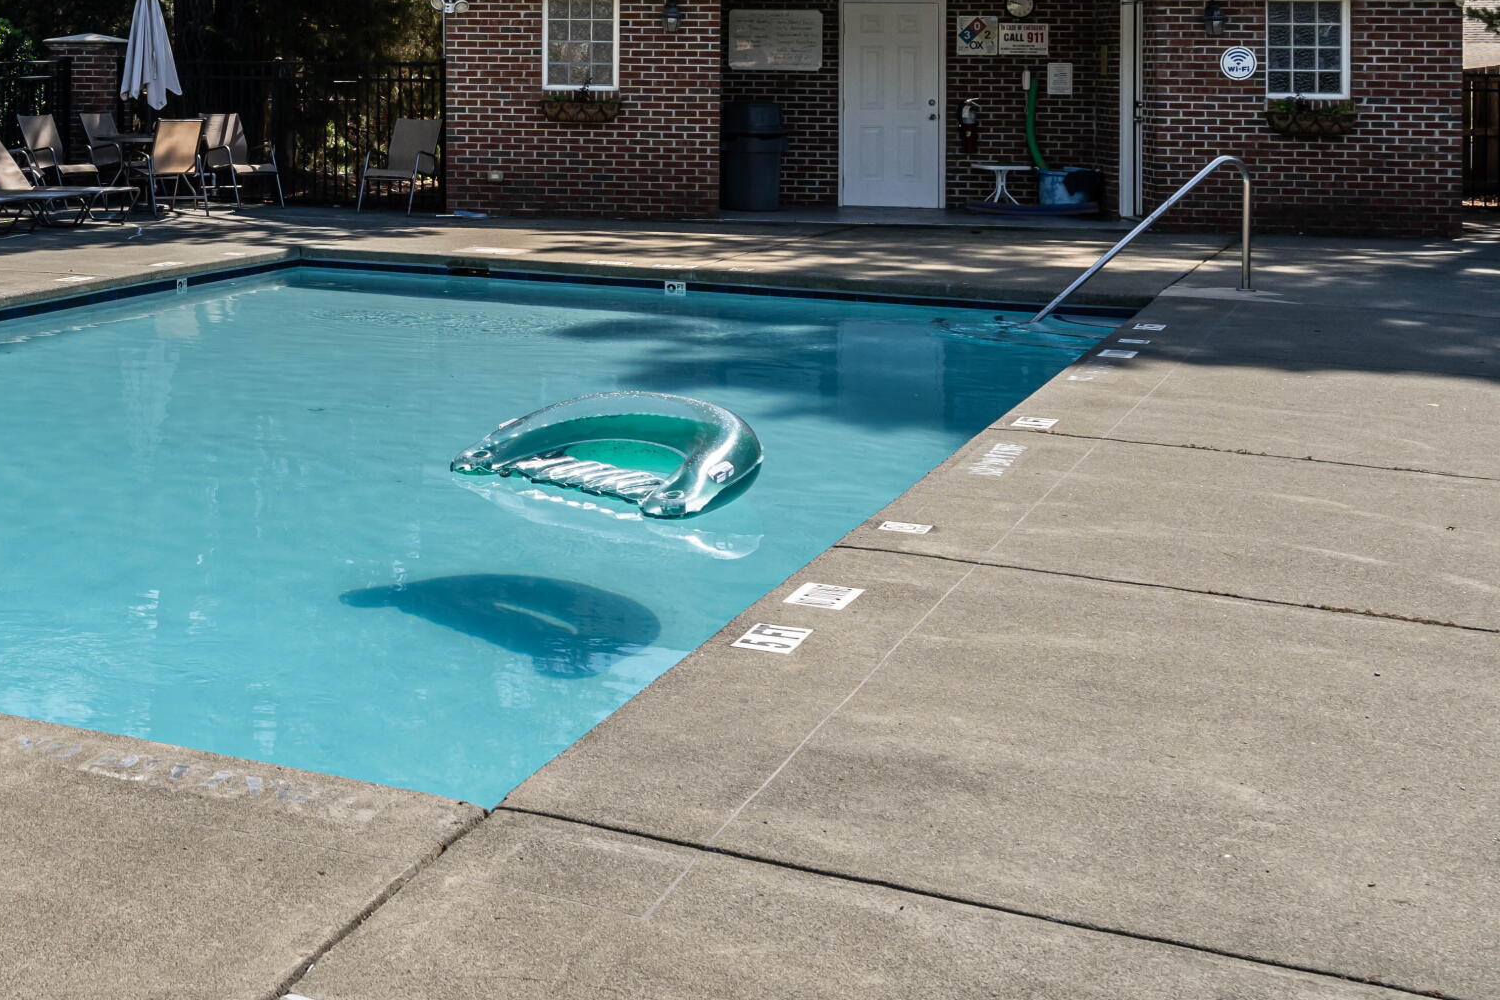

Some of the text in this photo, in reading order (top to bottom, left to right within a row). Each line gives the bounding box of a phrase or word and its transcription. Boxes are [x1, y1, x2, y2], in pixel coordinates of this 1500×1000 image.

[974, 22, 980, 30] 0
[964, 30, 970, 39] 3
[984, 30, 991, 39] 2
[1004, 32, 1044, 43] CALL 911
[970, 41, 983, 49] OX
[740, 624, 806, 649] 5 FT
